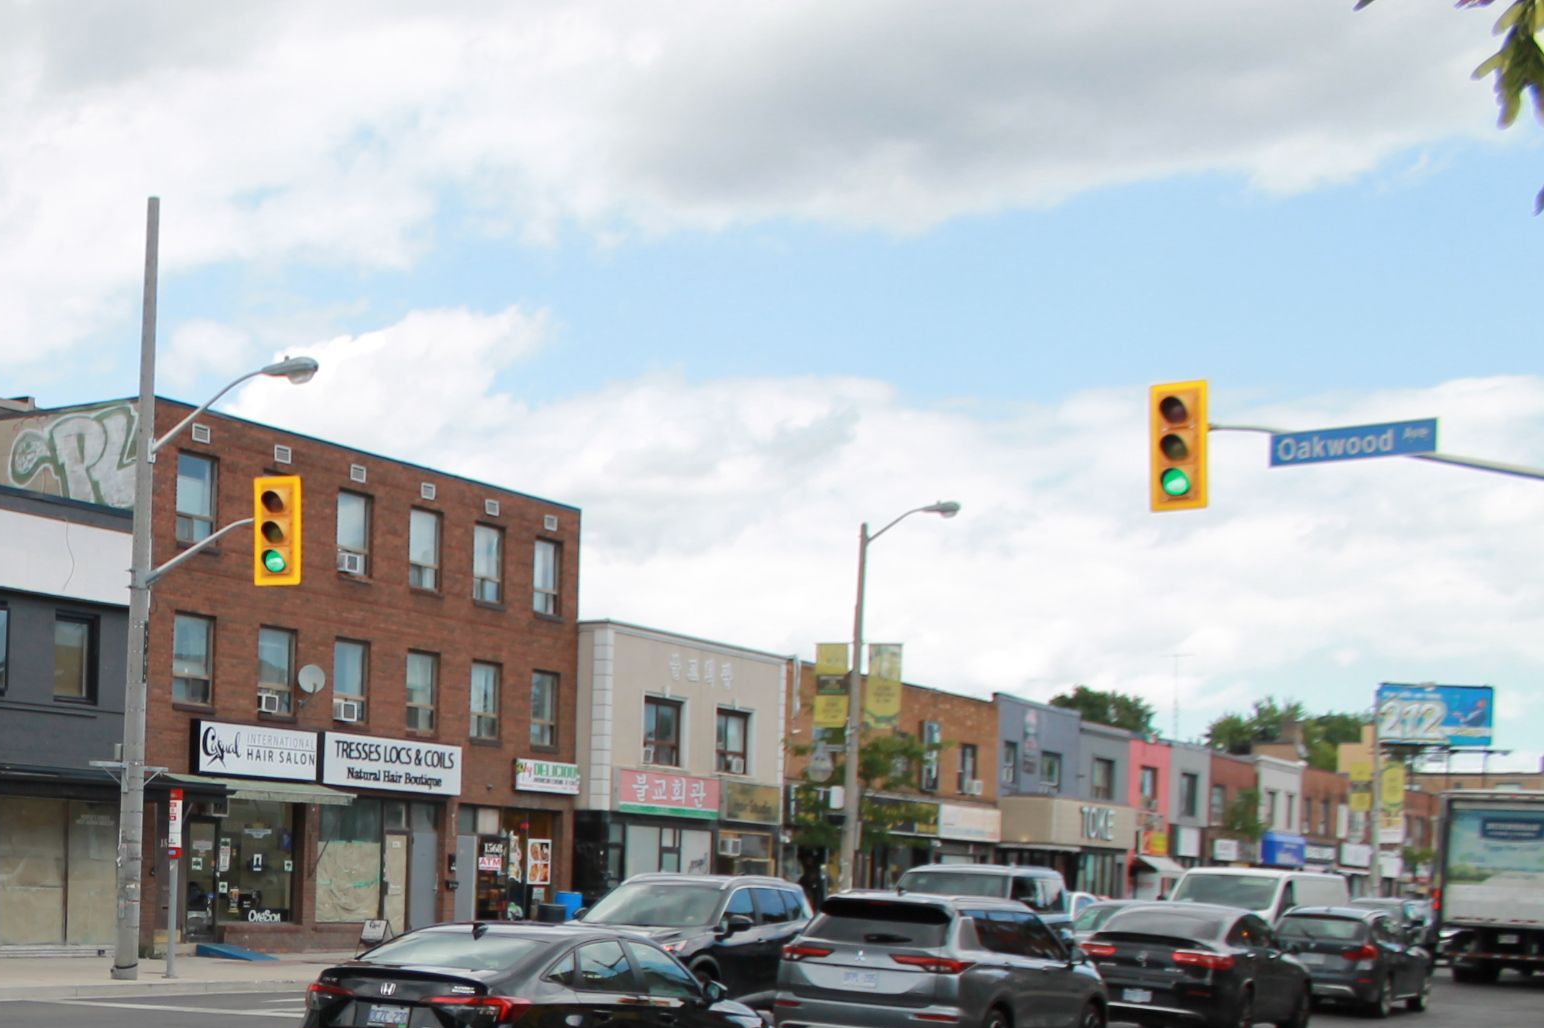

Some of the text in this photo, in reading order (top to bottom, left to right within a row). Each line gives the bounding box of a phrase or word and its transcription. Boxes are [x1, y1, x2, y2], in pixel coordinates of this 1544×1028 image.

[1277, 426, 1430, 461] Oakwood Ave
[202, 726, 241, 760] Casual
[247, 733, 315, 750] INTERNATIONAL
[335, 740, 454, 769] TRESSES LOCS & COILS
[247, 748, 316, 766] HAIR SALON
[347, 767, 442, 789] Natural Hair Boutique
[632, 774, 706, 808] 불교회관
[1080, 805, 1115, 841] TOKE
[479, 858, 501, 866] ATM
